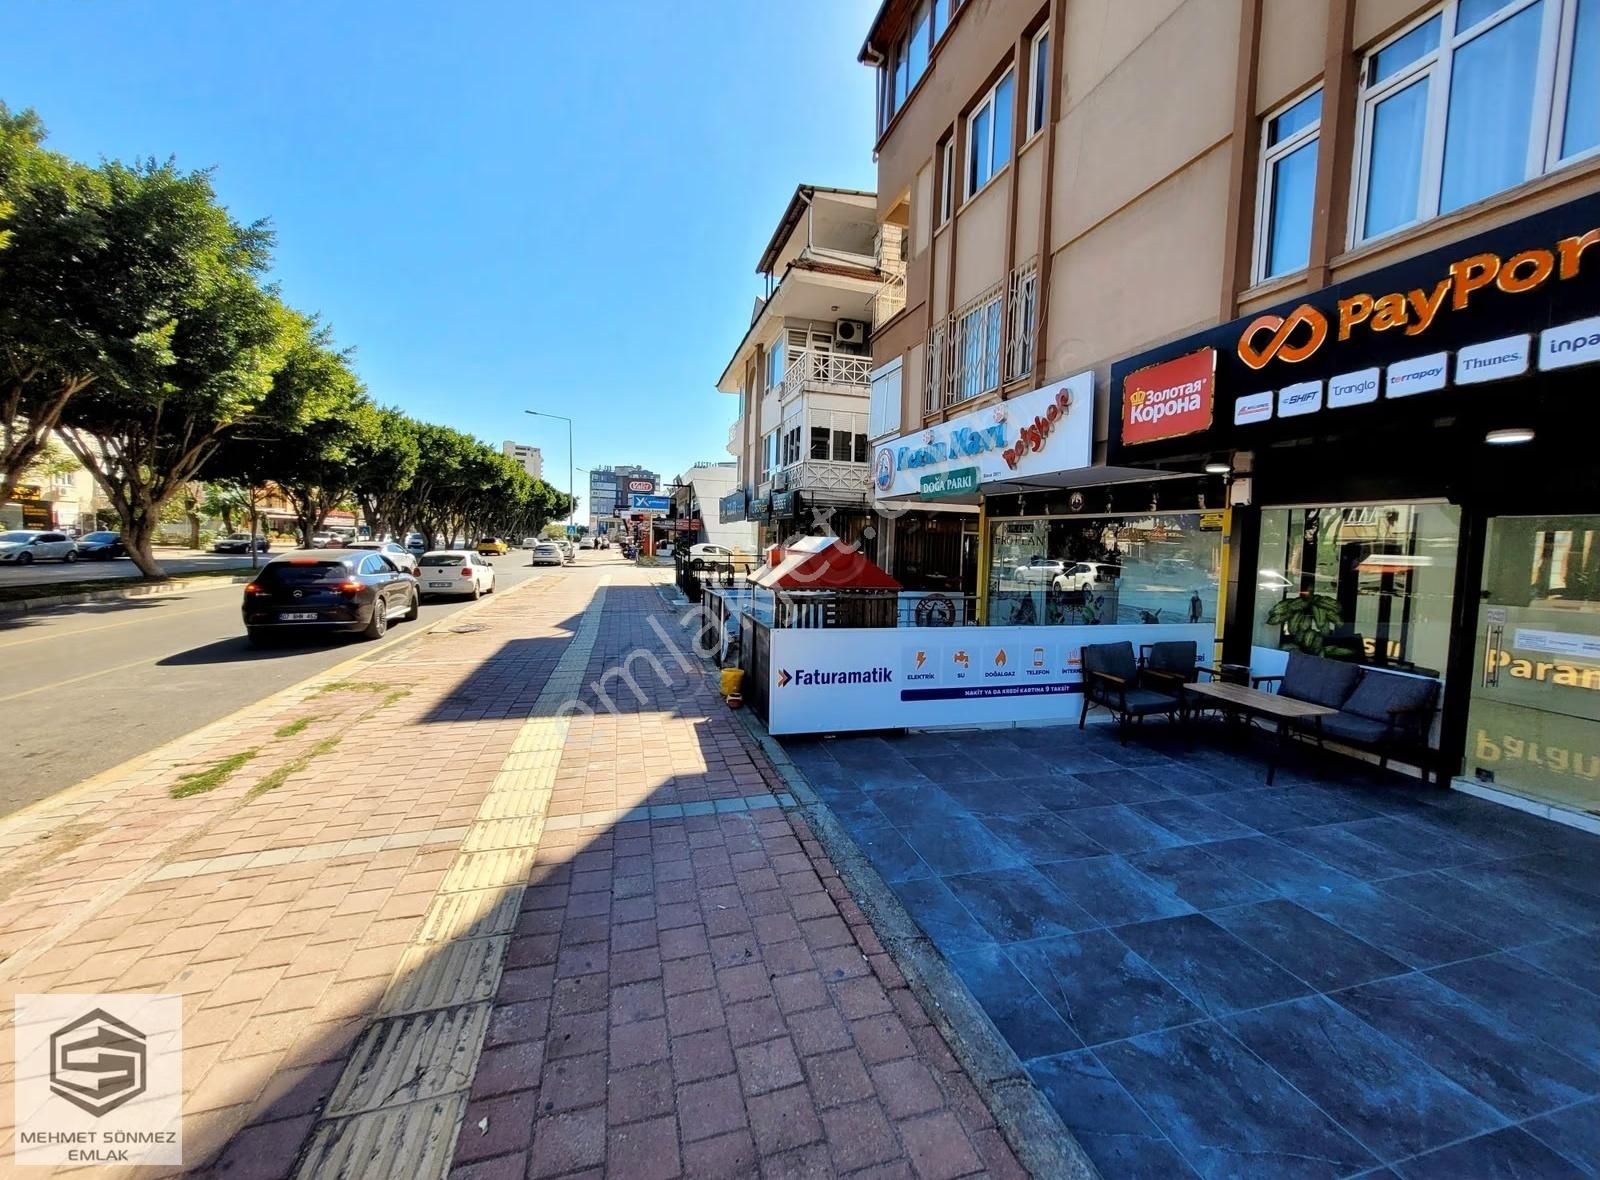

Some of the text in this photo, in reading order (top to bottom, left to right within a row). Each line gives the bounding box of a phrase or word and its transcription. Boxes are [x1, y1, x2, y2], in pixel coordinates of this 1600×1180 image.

[1390, 366, 1443, 384] terrapay
[1145, 379, 1202, 405] Золотая
[1332, 380, 1376, 396] Tranglo
[1130, 393, 1201, 425] Корона
[923, 474, 972, 494] DOĞA PARKI
[794, 667, 893, 686] Faturamatik
[907, 673, 935, 681] ELEKTRİK
[984, 670, 1016, 678] DOĞALGAZ
